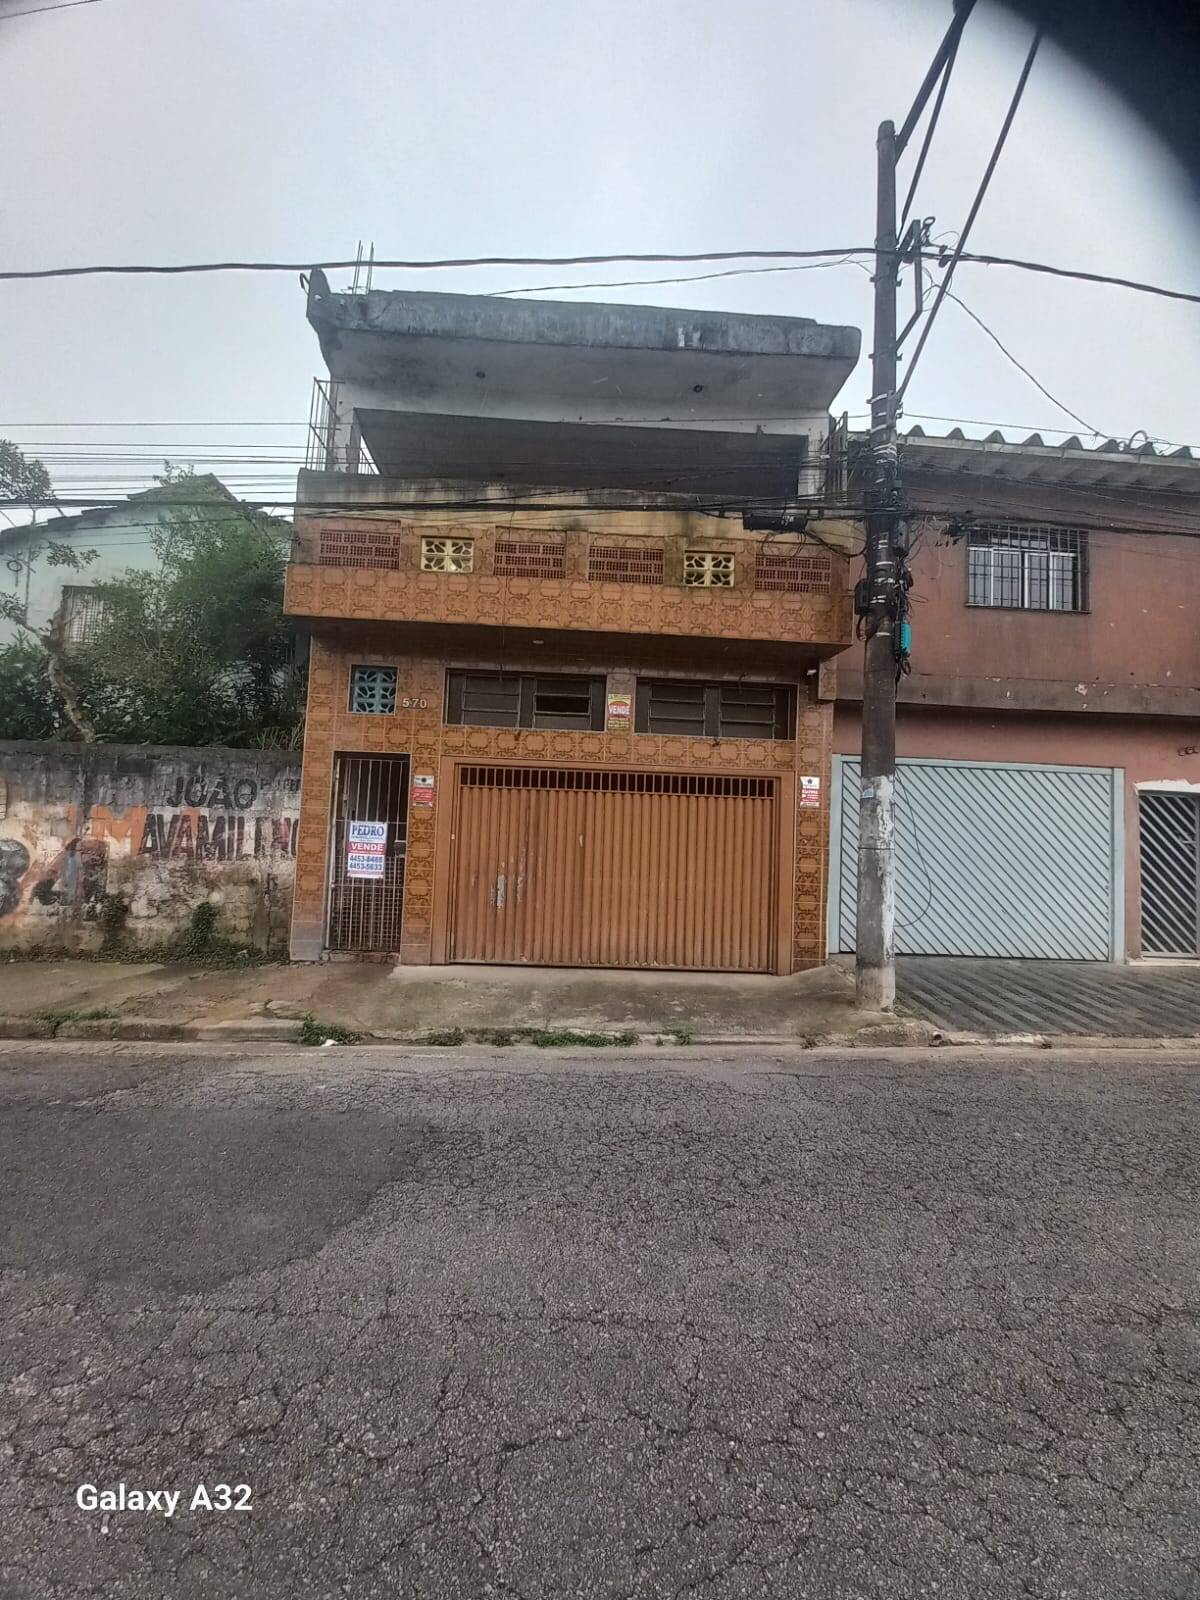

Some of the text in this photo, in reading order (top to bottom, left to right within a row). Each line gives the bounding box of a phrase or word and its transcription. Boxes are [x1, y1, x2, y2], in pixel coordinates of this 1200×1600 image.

[402, 697, 427, 709] 570
[352, 824, 384, 836] PEDRO
[351, 842, 384, 851] VENDE
